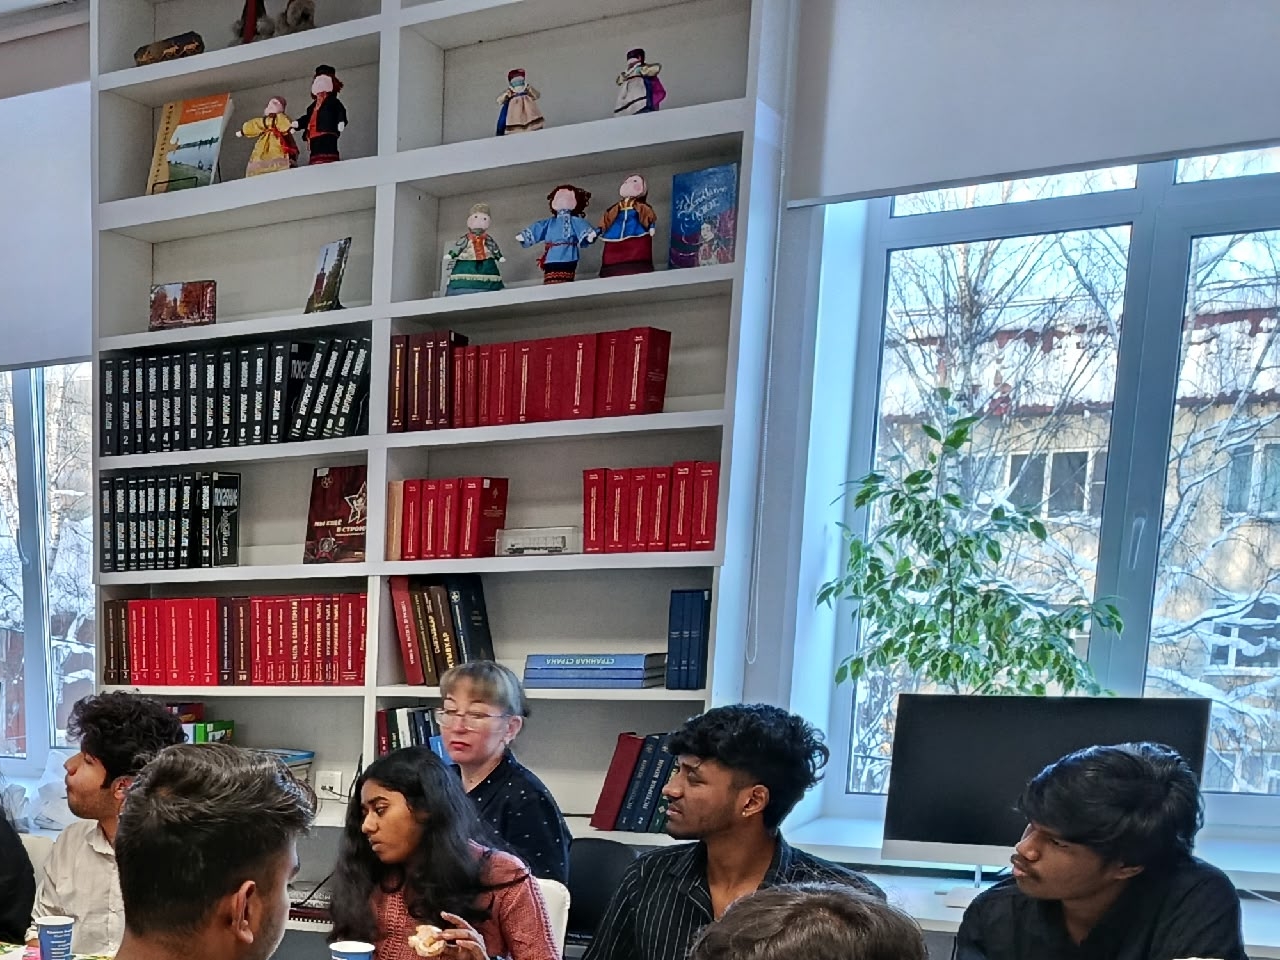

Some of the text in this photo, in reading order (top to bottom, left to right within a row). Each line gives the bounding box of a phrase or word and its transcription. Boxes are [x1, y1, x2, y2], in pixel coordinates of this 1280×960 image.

[442, 632, 455, 669] КТЫВКАР
[643, 782, 657, 809] ИСТОРИЯ
[653, 759, 665, 779] КОМИ
